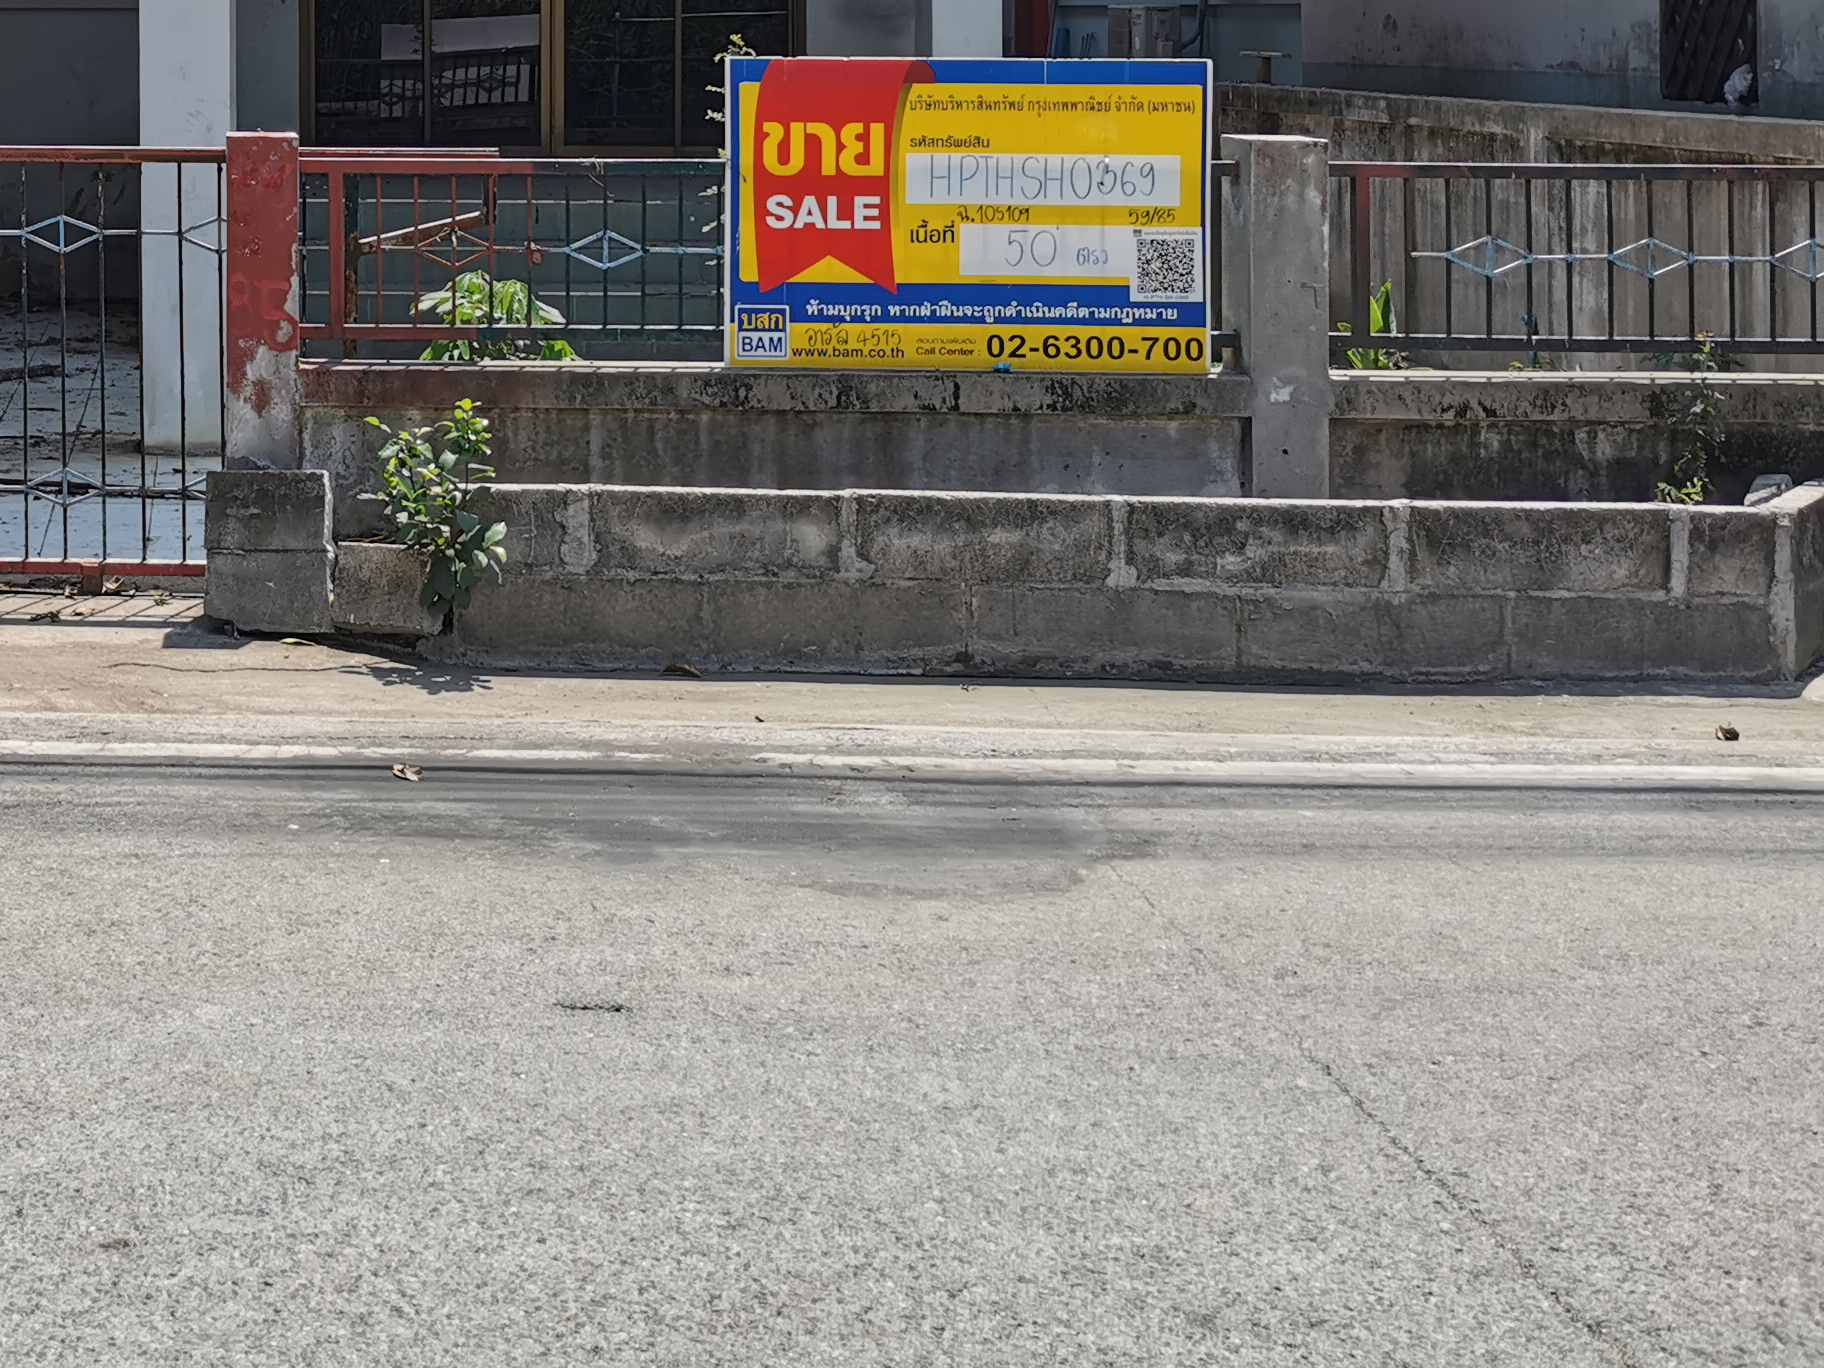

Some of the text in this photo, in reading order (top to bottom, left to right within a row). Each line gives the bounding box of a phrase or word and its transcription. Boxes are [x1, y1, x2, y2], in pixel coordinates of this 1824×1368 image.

[909, 94, 1196, 118] บริษัทบริหารสินทรัพย์ กรุงเทพพาณิชย์ จำกัด (มหาชน)
[762, 121, 885, 177] ขาย
[909, 135, 991, 149] รหัสทรัพย์สิน
[765, 194, 882, 230] SALE
[1128, 206, 1177, 226] 59/85
[909, 219, 955, 244] เนื้อที่
[1004, 229, 1058, 267] 50
[740, 312, 784, 330] บสก
[805, 298, 882, 322] ห้ามบุกรุก
[741, 336, 784, 353] BAM
[856, 327, 902, 347] 4515
[986, 334, 1205, 362] 02-6300-700
[791, 346, 905, 359] www.bam.co.th
[915, 346, 936, 356] Call
[938, 346, 975, 356] Center
